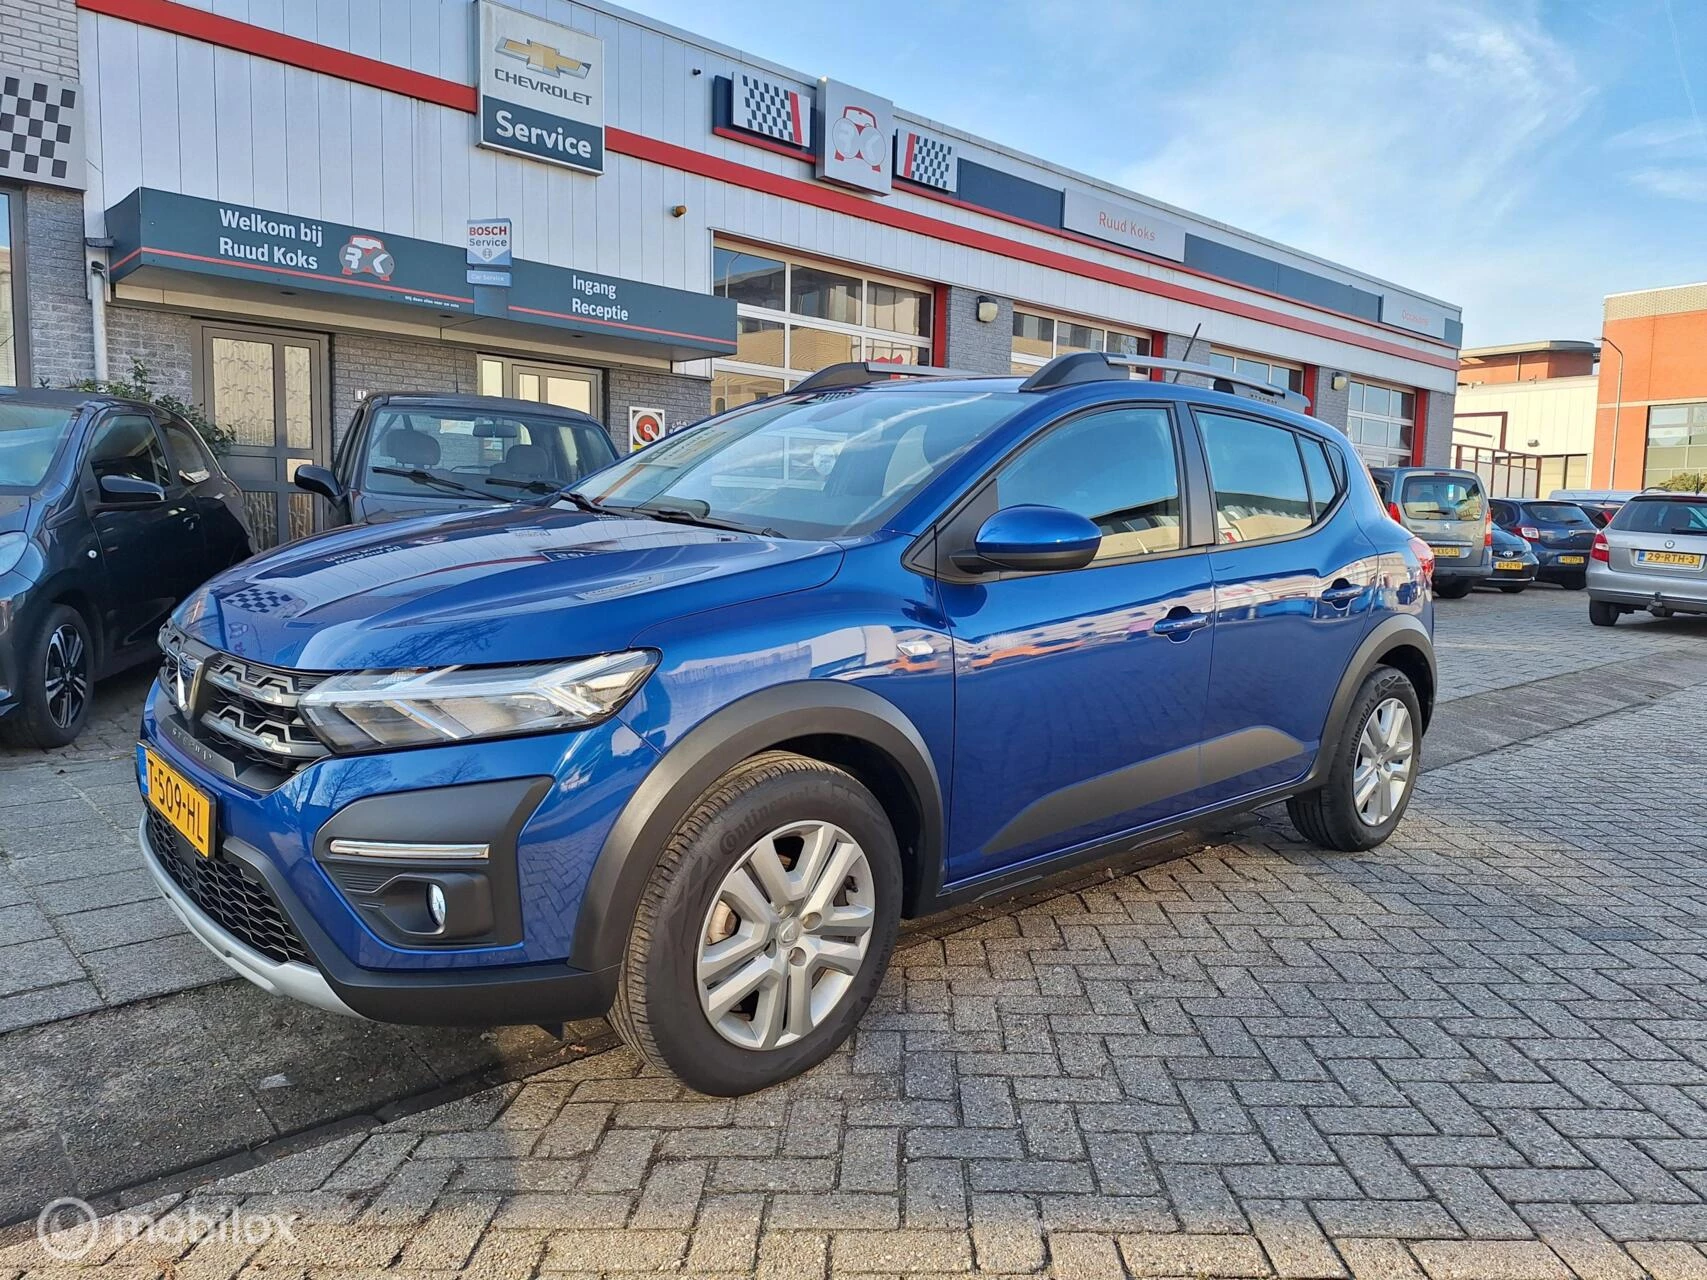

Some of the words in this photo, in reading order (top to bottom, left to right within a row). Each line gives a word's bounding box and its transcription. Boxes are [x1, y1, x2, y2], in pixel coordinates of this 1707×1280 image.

[494, 68, 592, 106] CHEVROLET
[495, 109, 592, 159] Service
[219, 208, 296, 239] Welkom
[300, 222, 324, 248] bij
[468, 226, 508, 237] BOSCH
[1098, 211, 1128, 233] Ruud
[1130, 221, 1157, 241] Koks
[219, 236, 269, 263] Ruud
[273, 246, 318, 270] Koks
[468, 237, 508, 248] Service
[572, 274, 617, 300] Ingang
[571, 297, 629, 321] Receptie
[1647, 552, 1696, 565] 29-RTH-3
[146, 757, 205, 844] T-509-HL
